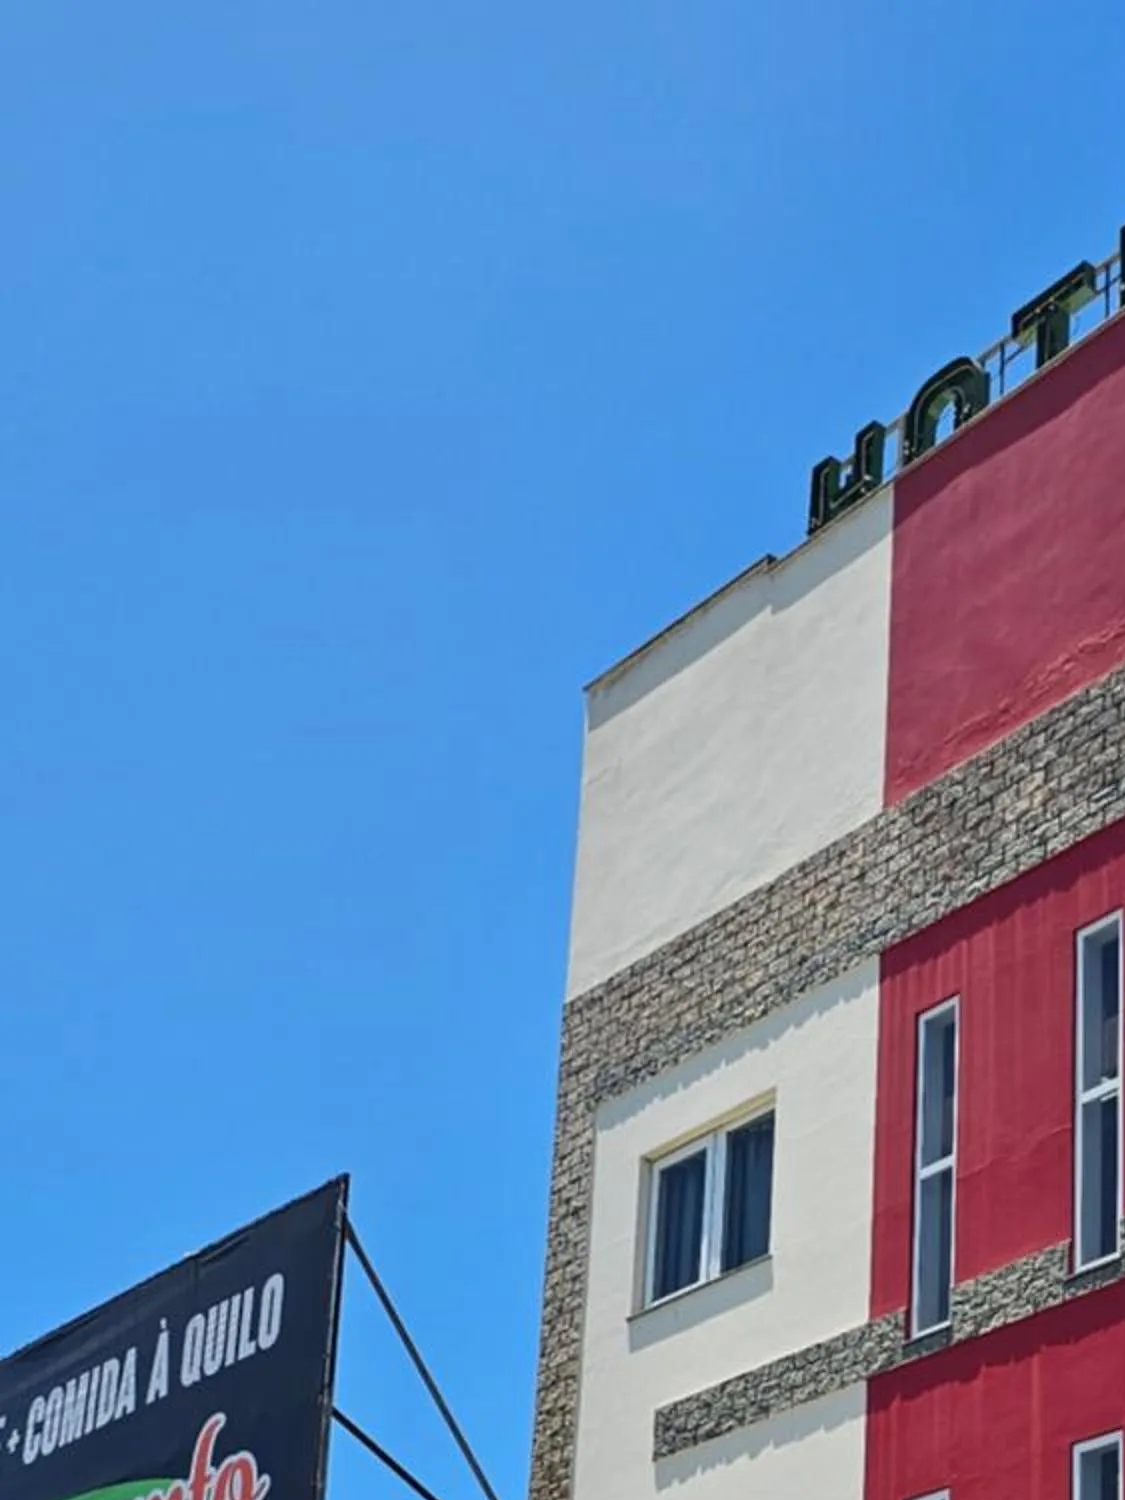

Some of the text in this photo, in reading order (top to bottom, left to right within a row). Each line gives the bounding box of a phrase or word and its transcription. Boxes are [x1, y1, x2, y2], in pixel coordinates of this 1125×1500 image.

[22, 1346, 137, 1465] COMIDA
[145, 1317, 169, 1405] À
[180, 1272, 285, 1388] QUILO
